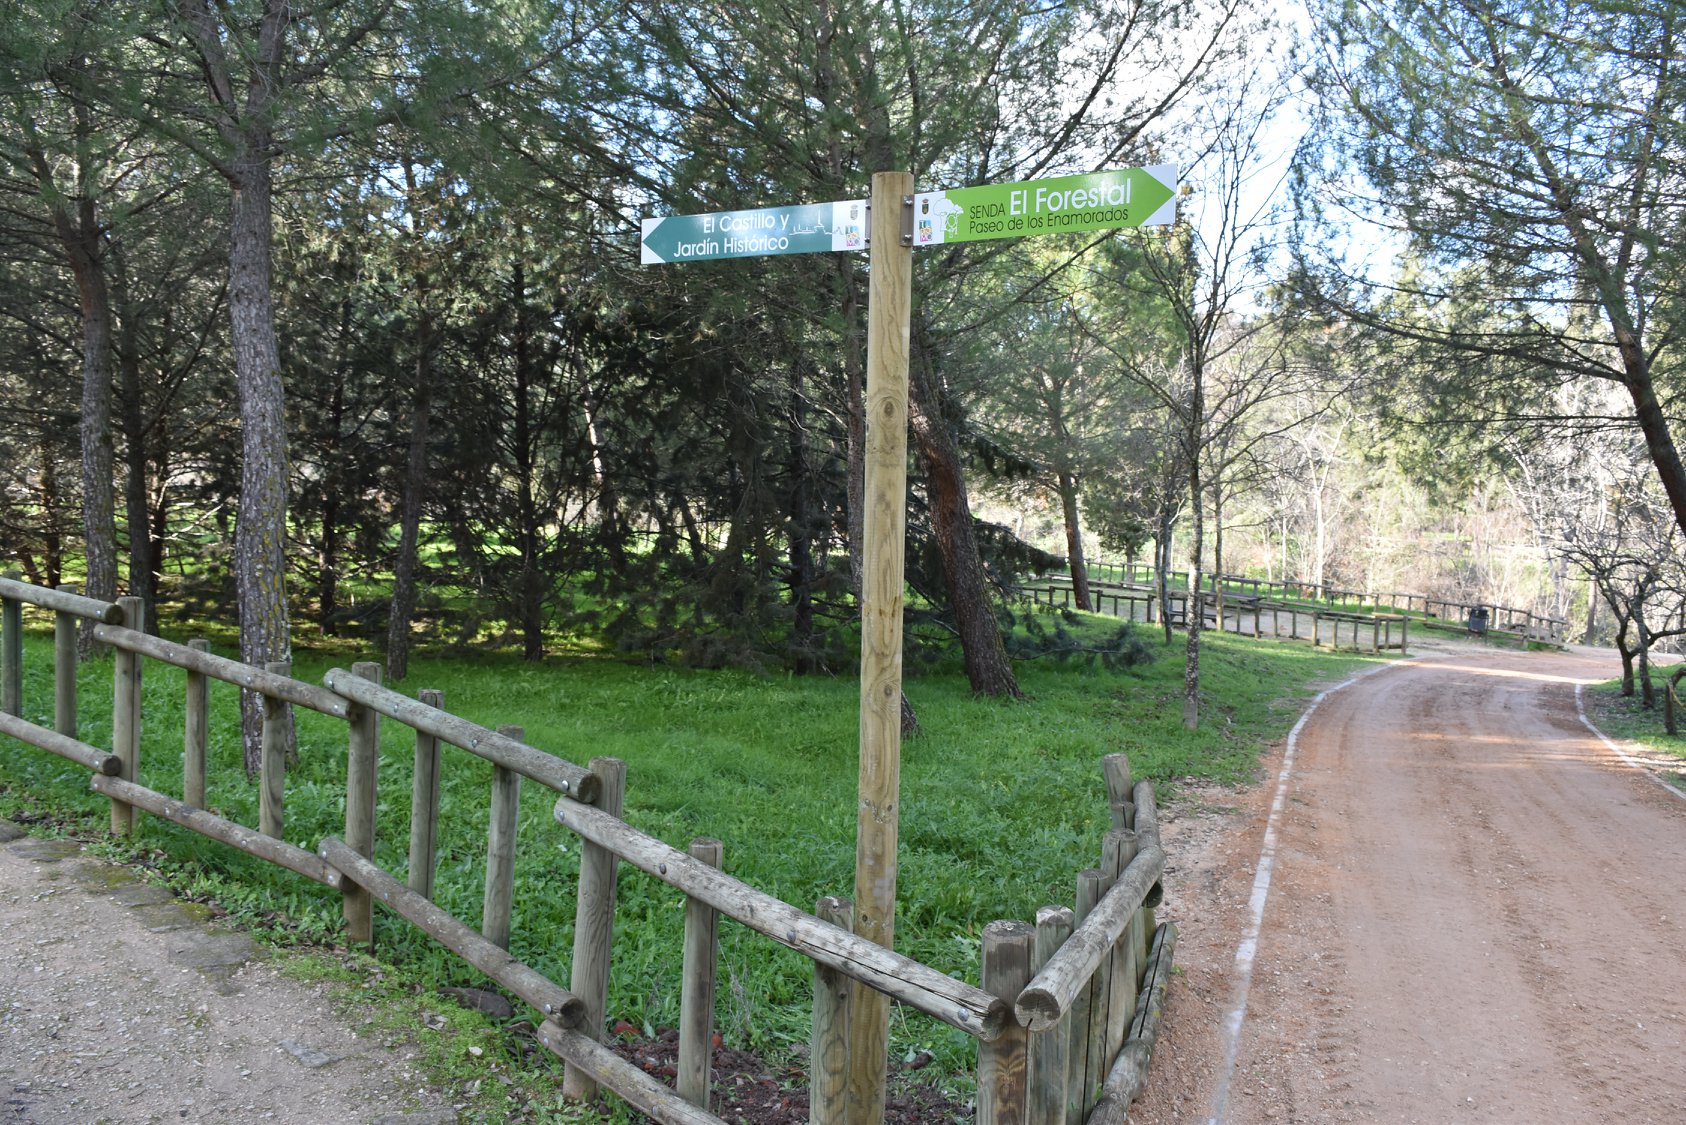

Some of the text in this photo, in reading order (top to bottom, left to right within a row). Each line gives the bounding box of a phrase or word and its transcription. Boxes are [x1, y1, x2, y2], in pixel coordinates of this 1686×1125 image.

[970, 178, 1131, 219] SENDA El Forestal
[703, 214, 790, 233] El Castillo y
[969, 207, 1129, 234] Paseo de los Enamorados
[673, 235, 789, 257] Jardín Histórico
